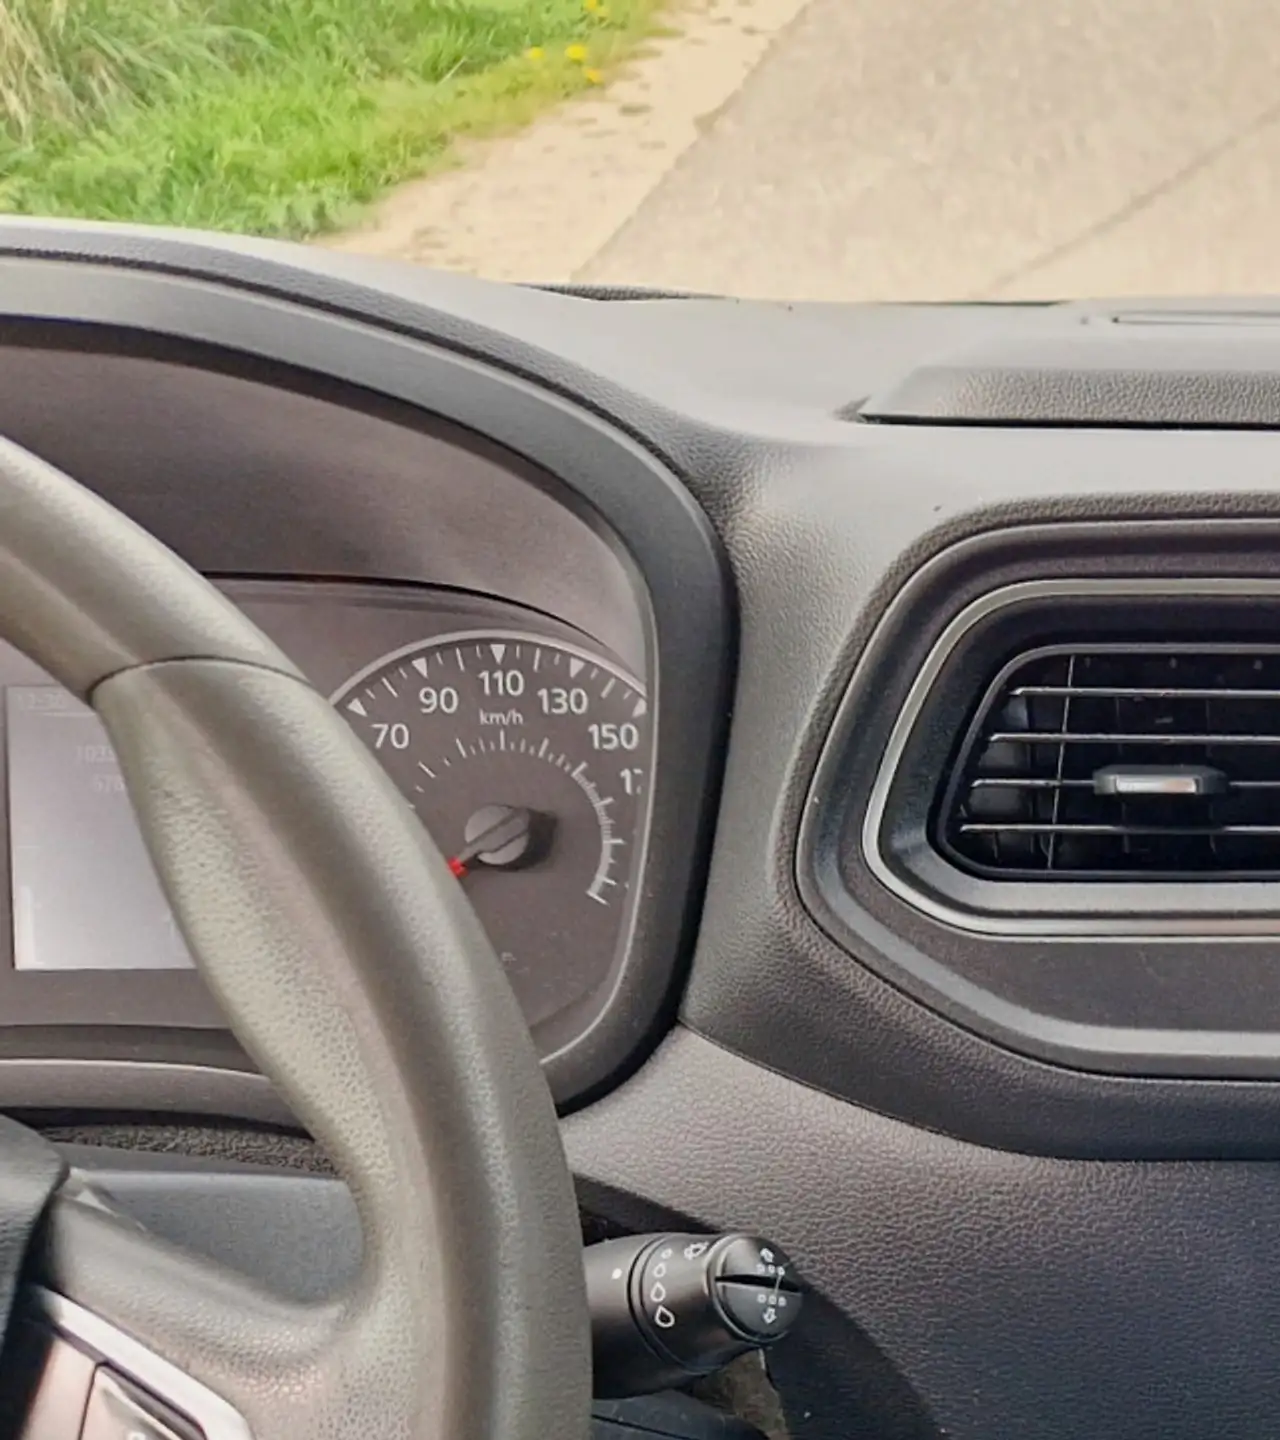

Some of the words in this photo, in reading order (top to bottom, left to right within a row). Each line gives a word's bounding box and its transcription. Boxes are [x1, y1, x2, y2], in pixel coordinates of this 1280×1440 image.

[370, 722, 410, 750] 70
[418, 687, 459, 714] 90
[477, 669, 525, 697] 110
[536, 687, 589, 715] 130
[587, 723, 639, 750] 150
[479, 708, 524, 726] km/h
